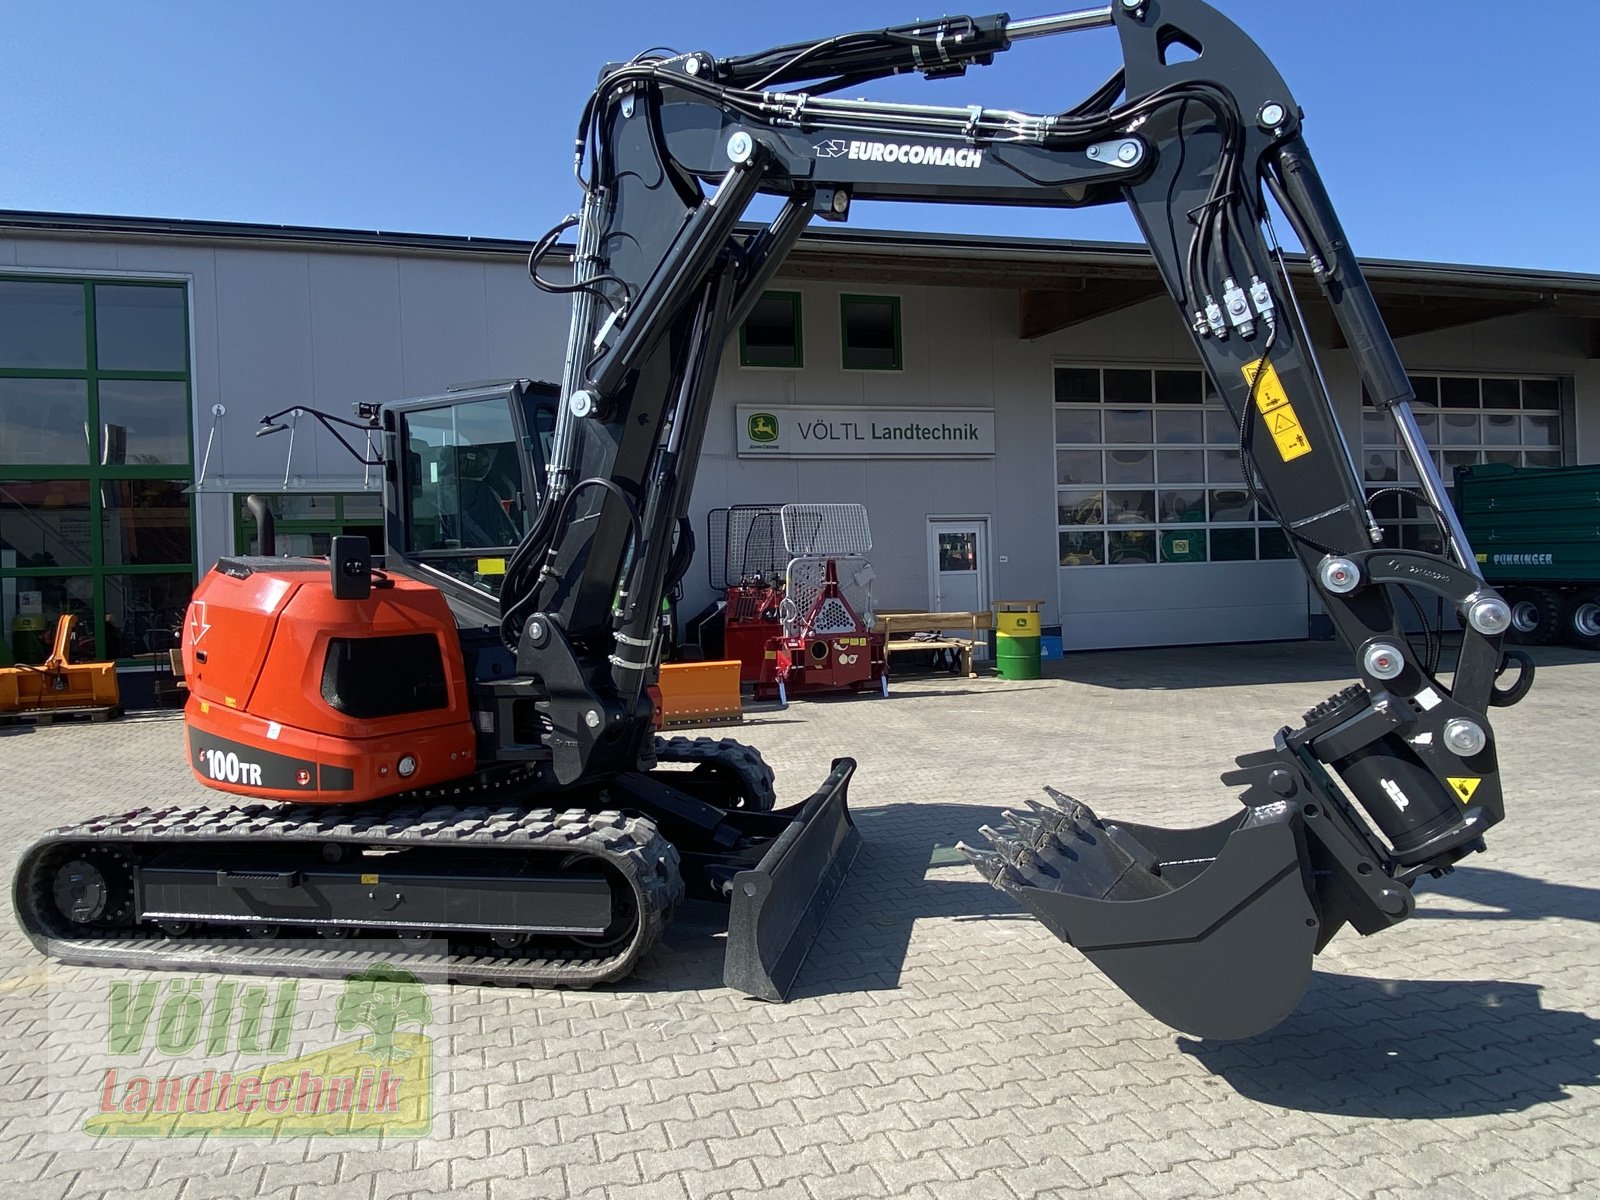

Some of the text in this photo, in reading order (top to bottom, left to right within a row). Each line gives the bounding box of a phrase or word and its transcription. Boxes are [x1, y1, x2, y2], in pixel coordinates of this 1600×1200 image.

[848, 141, 983, 168] EUROCOMACH
[798, 419, 979, 441] VÖLTL Landtechnik
